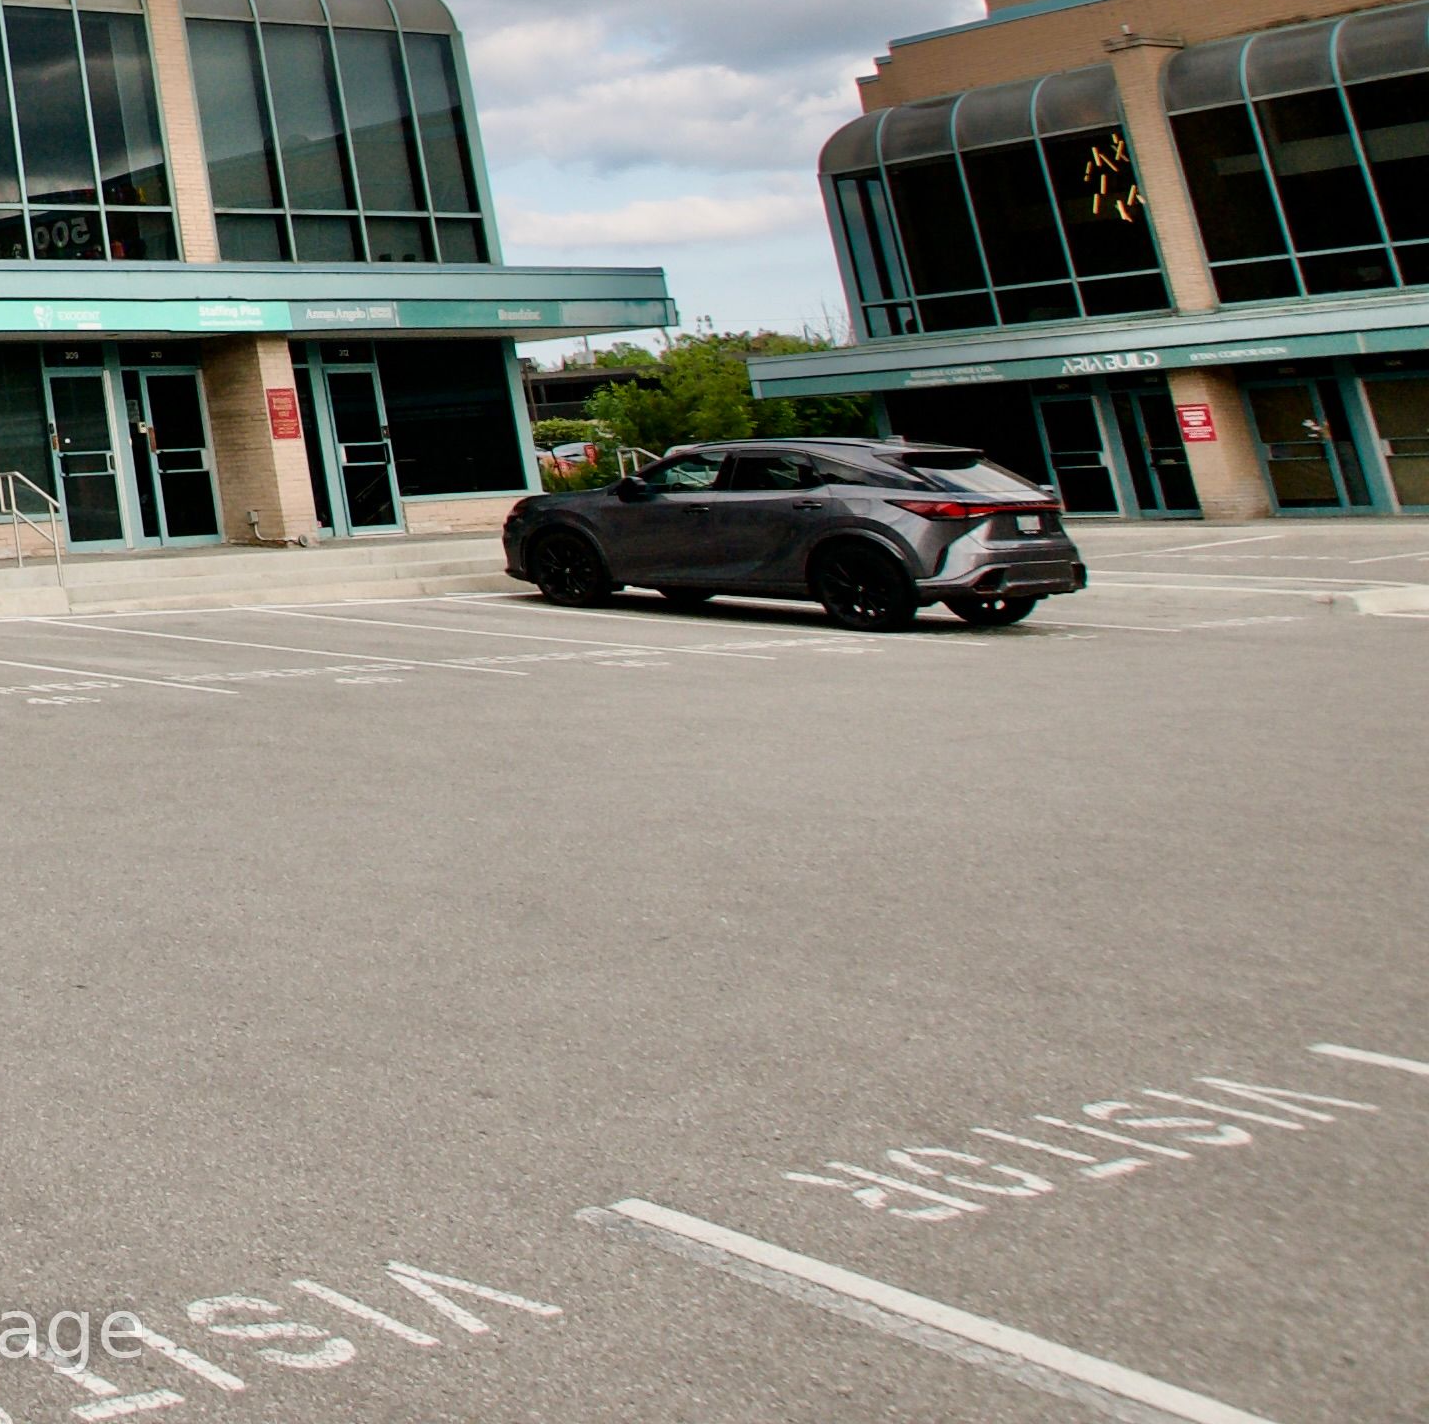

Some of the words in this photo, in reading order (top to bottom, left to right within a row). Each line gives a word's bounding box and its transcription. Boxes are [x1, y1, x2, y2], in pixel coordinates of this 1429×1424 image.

[199, 305, 238, 318] Staffing
[240, 305, 261, 316] Plus
[781, 1075, 1381, 1222] VISITOR
